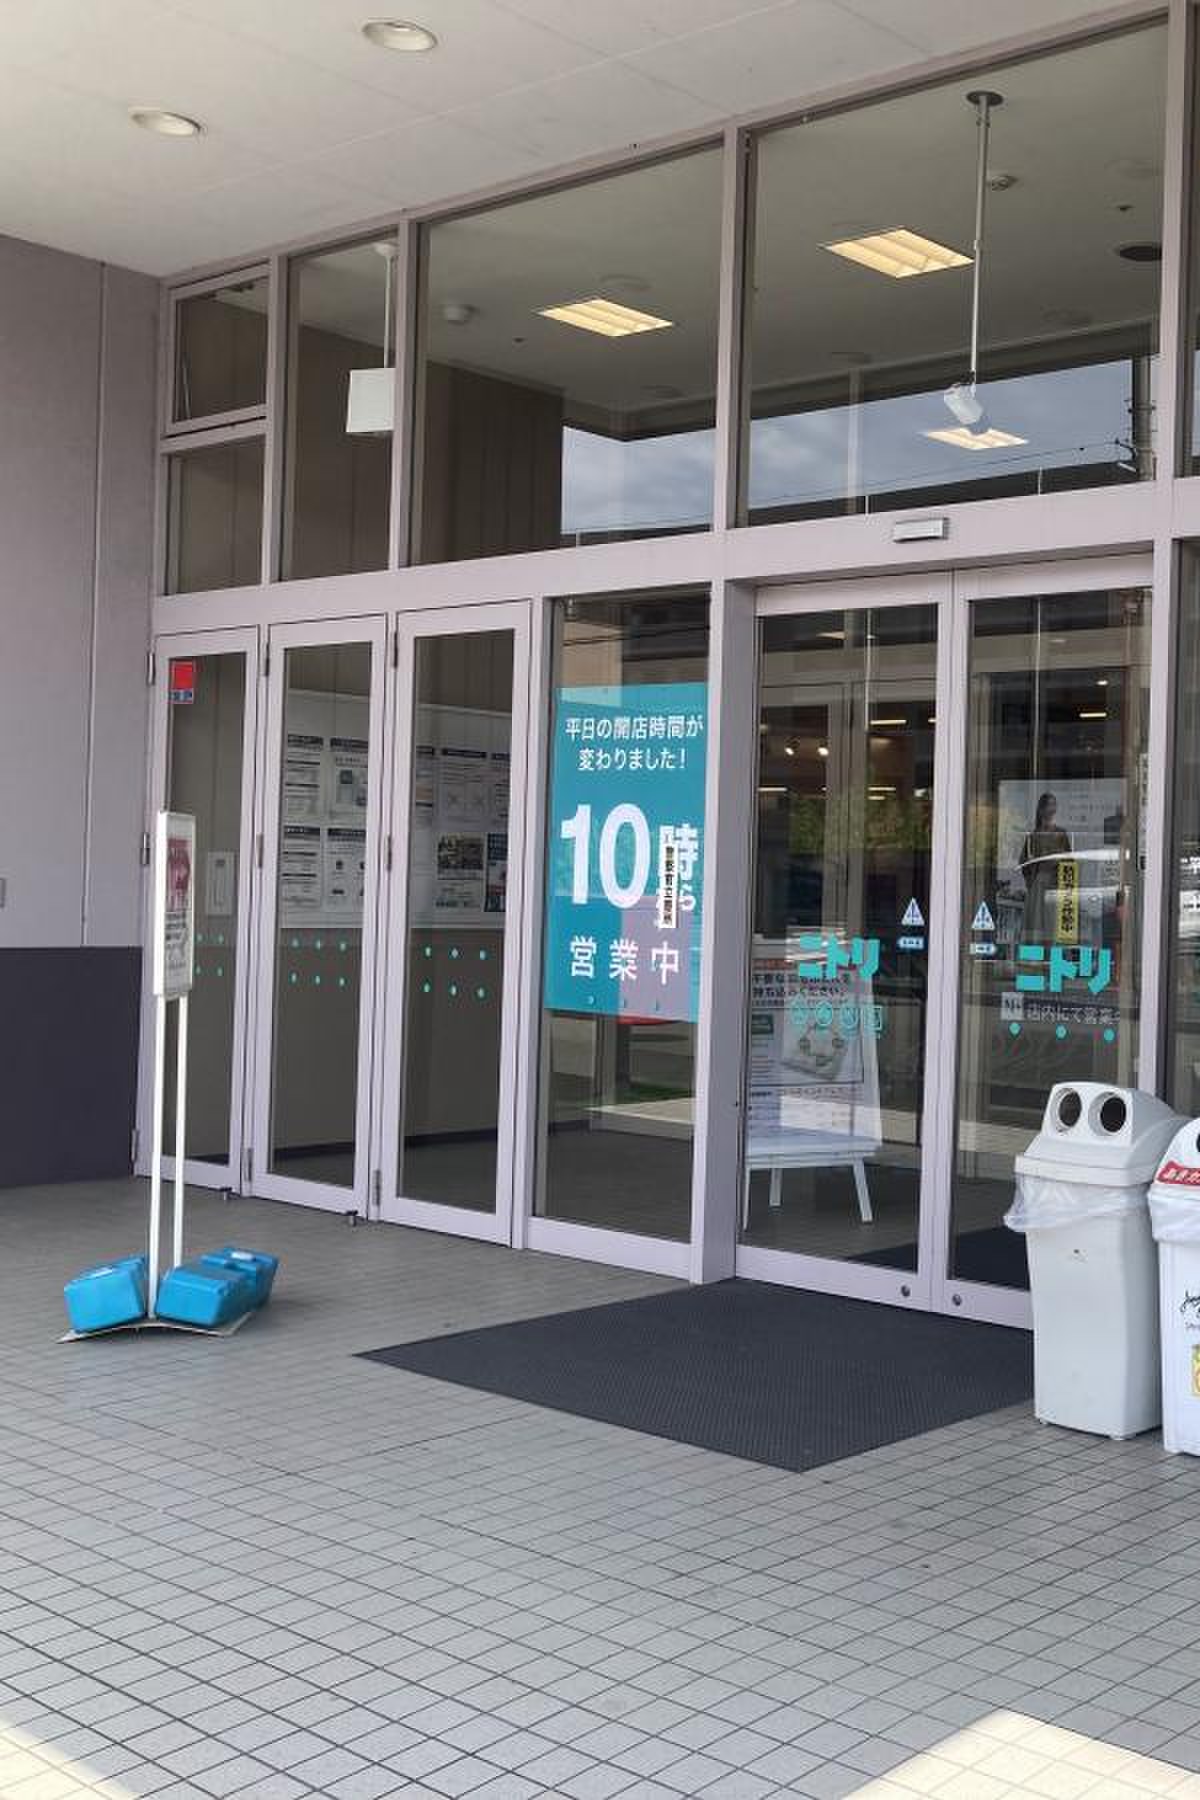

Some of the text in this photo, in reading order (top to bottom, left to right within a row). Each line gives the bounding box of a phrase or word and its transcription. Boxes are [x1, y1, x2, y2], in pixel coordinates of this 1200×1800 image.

[565, 715, 703, 742] 平日の開店時間が
[578, 749, 686, 771] 変わりました!
[571, 937, 680, 986] 営業中
[799, 931, 880, 981] ニトリ
[1015, 946, 1112, 993] ニトリ
